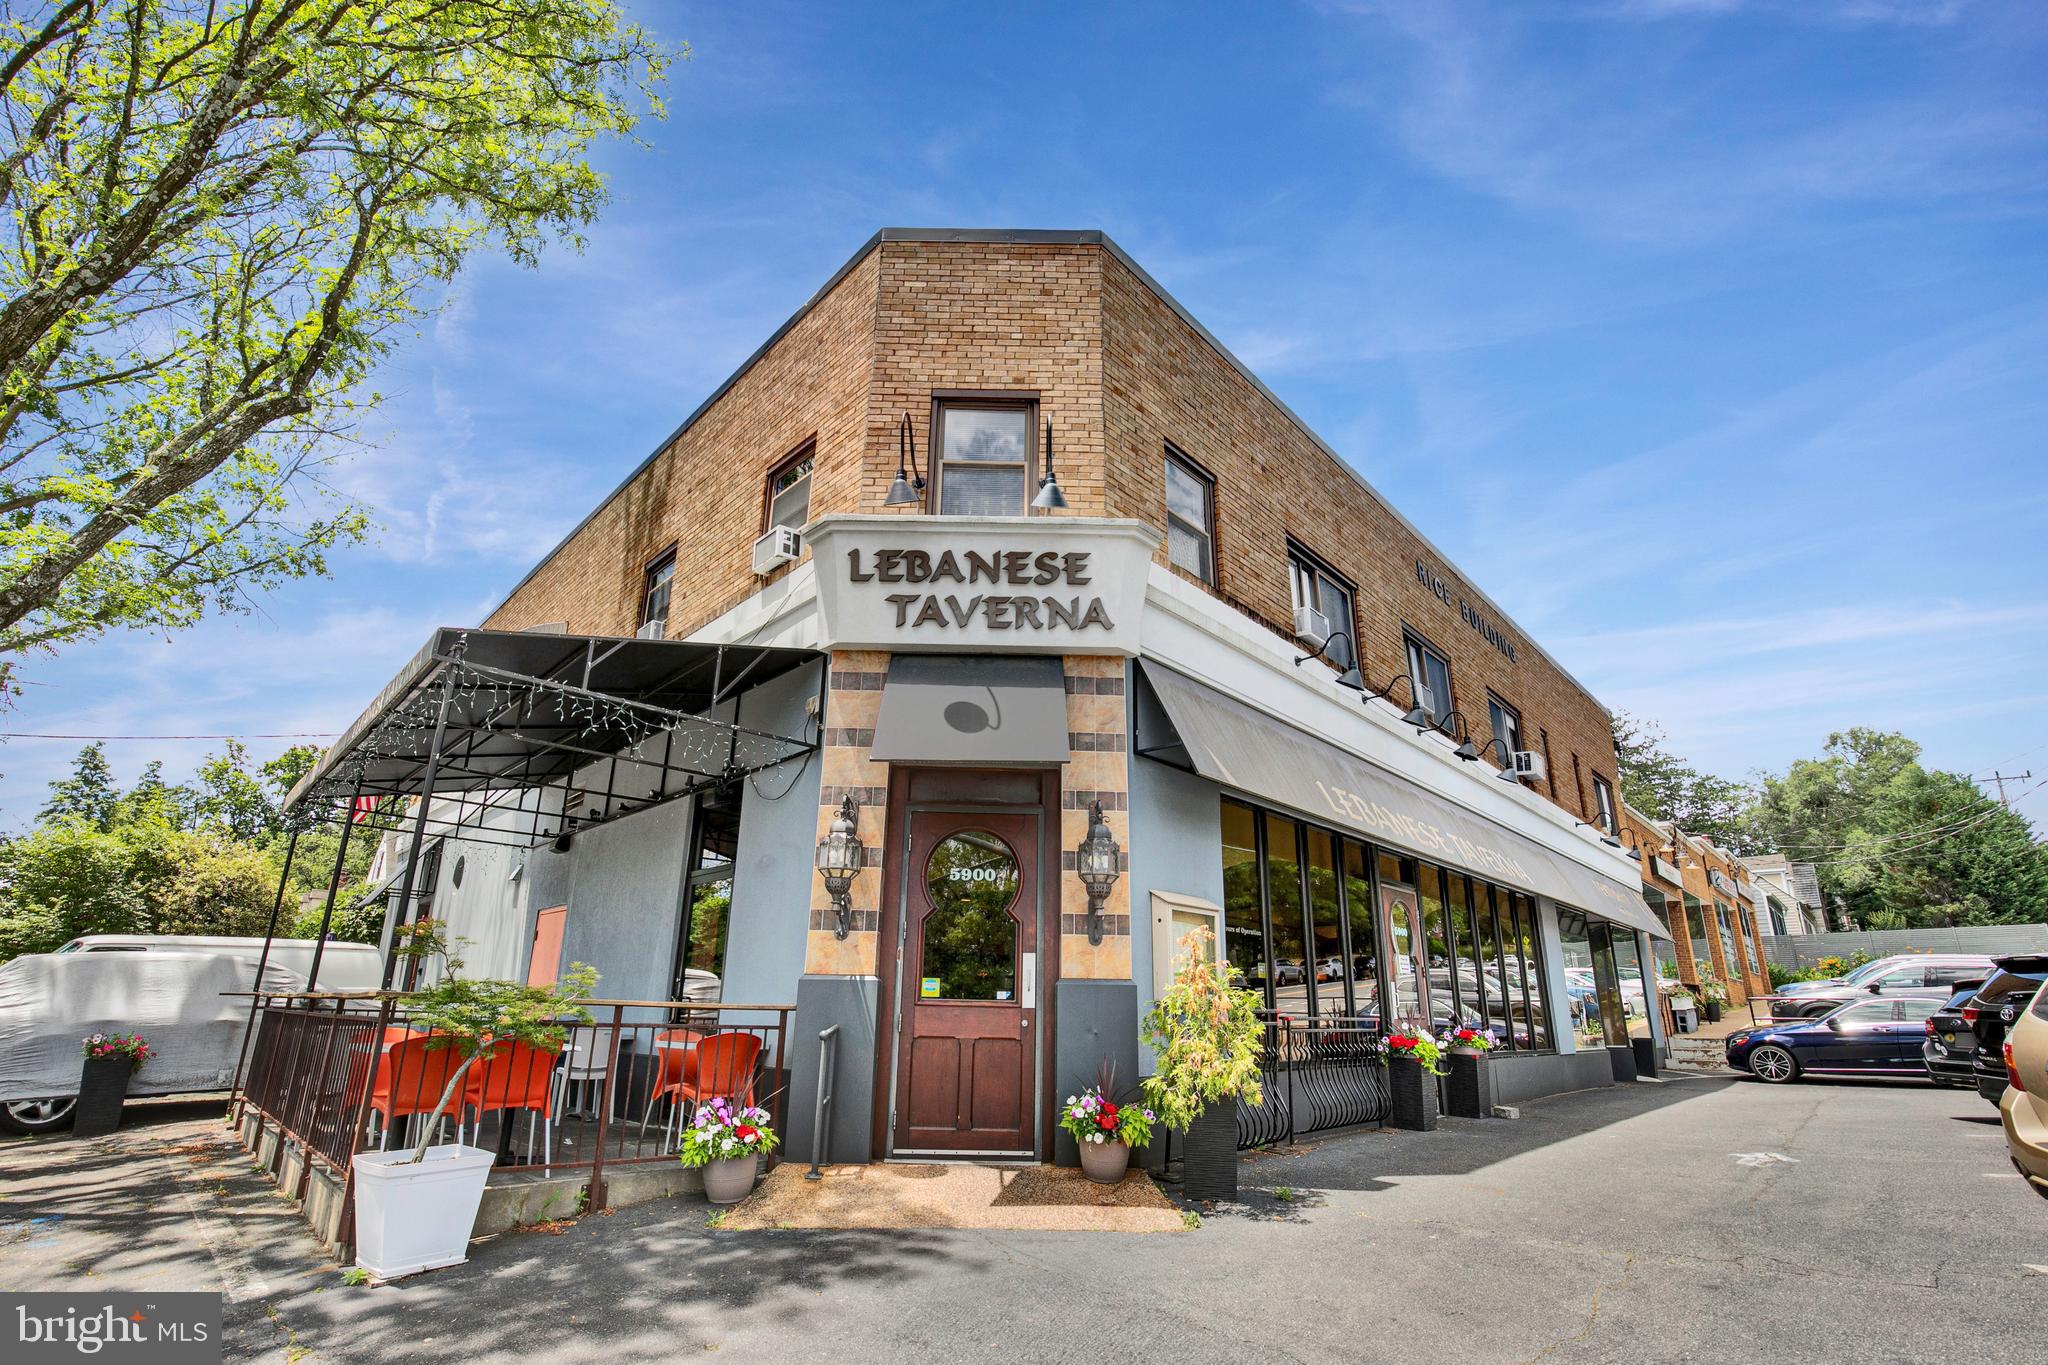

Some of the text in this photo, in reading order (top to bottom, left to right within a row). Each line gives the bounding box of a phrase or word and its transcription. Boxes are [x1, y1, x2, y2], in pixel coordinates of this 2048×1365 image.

[848, 548, 1092, 585] LEBANESE
[884, 594, 1115, 631] TAVERNA
[1416, 560, 1518, 663] RICE BUILDING
[1315, 780, 1535, 885] LEBANESE TAVERNA
[949, 868, 996, 882] 5900
